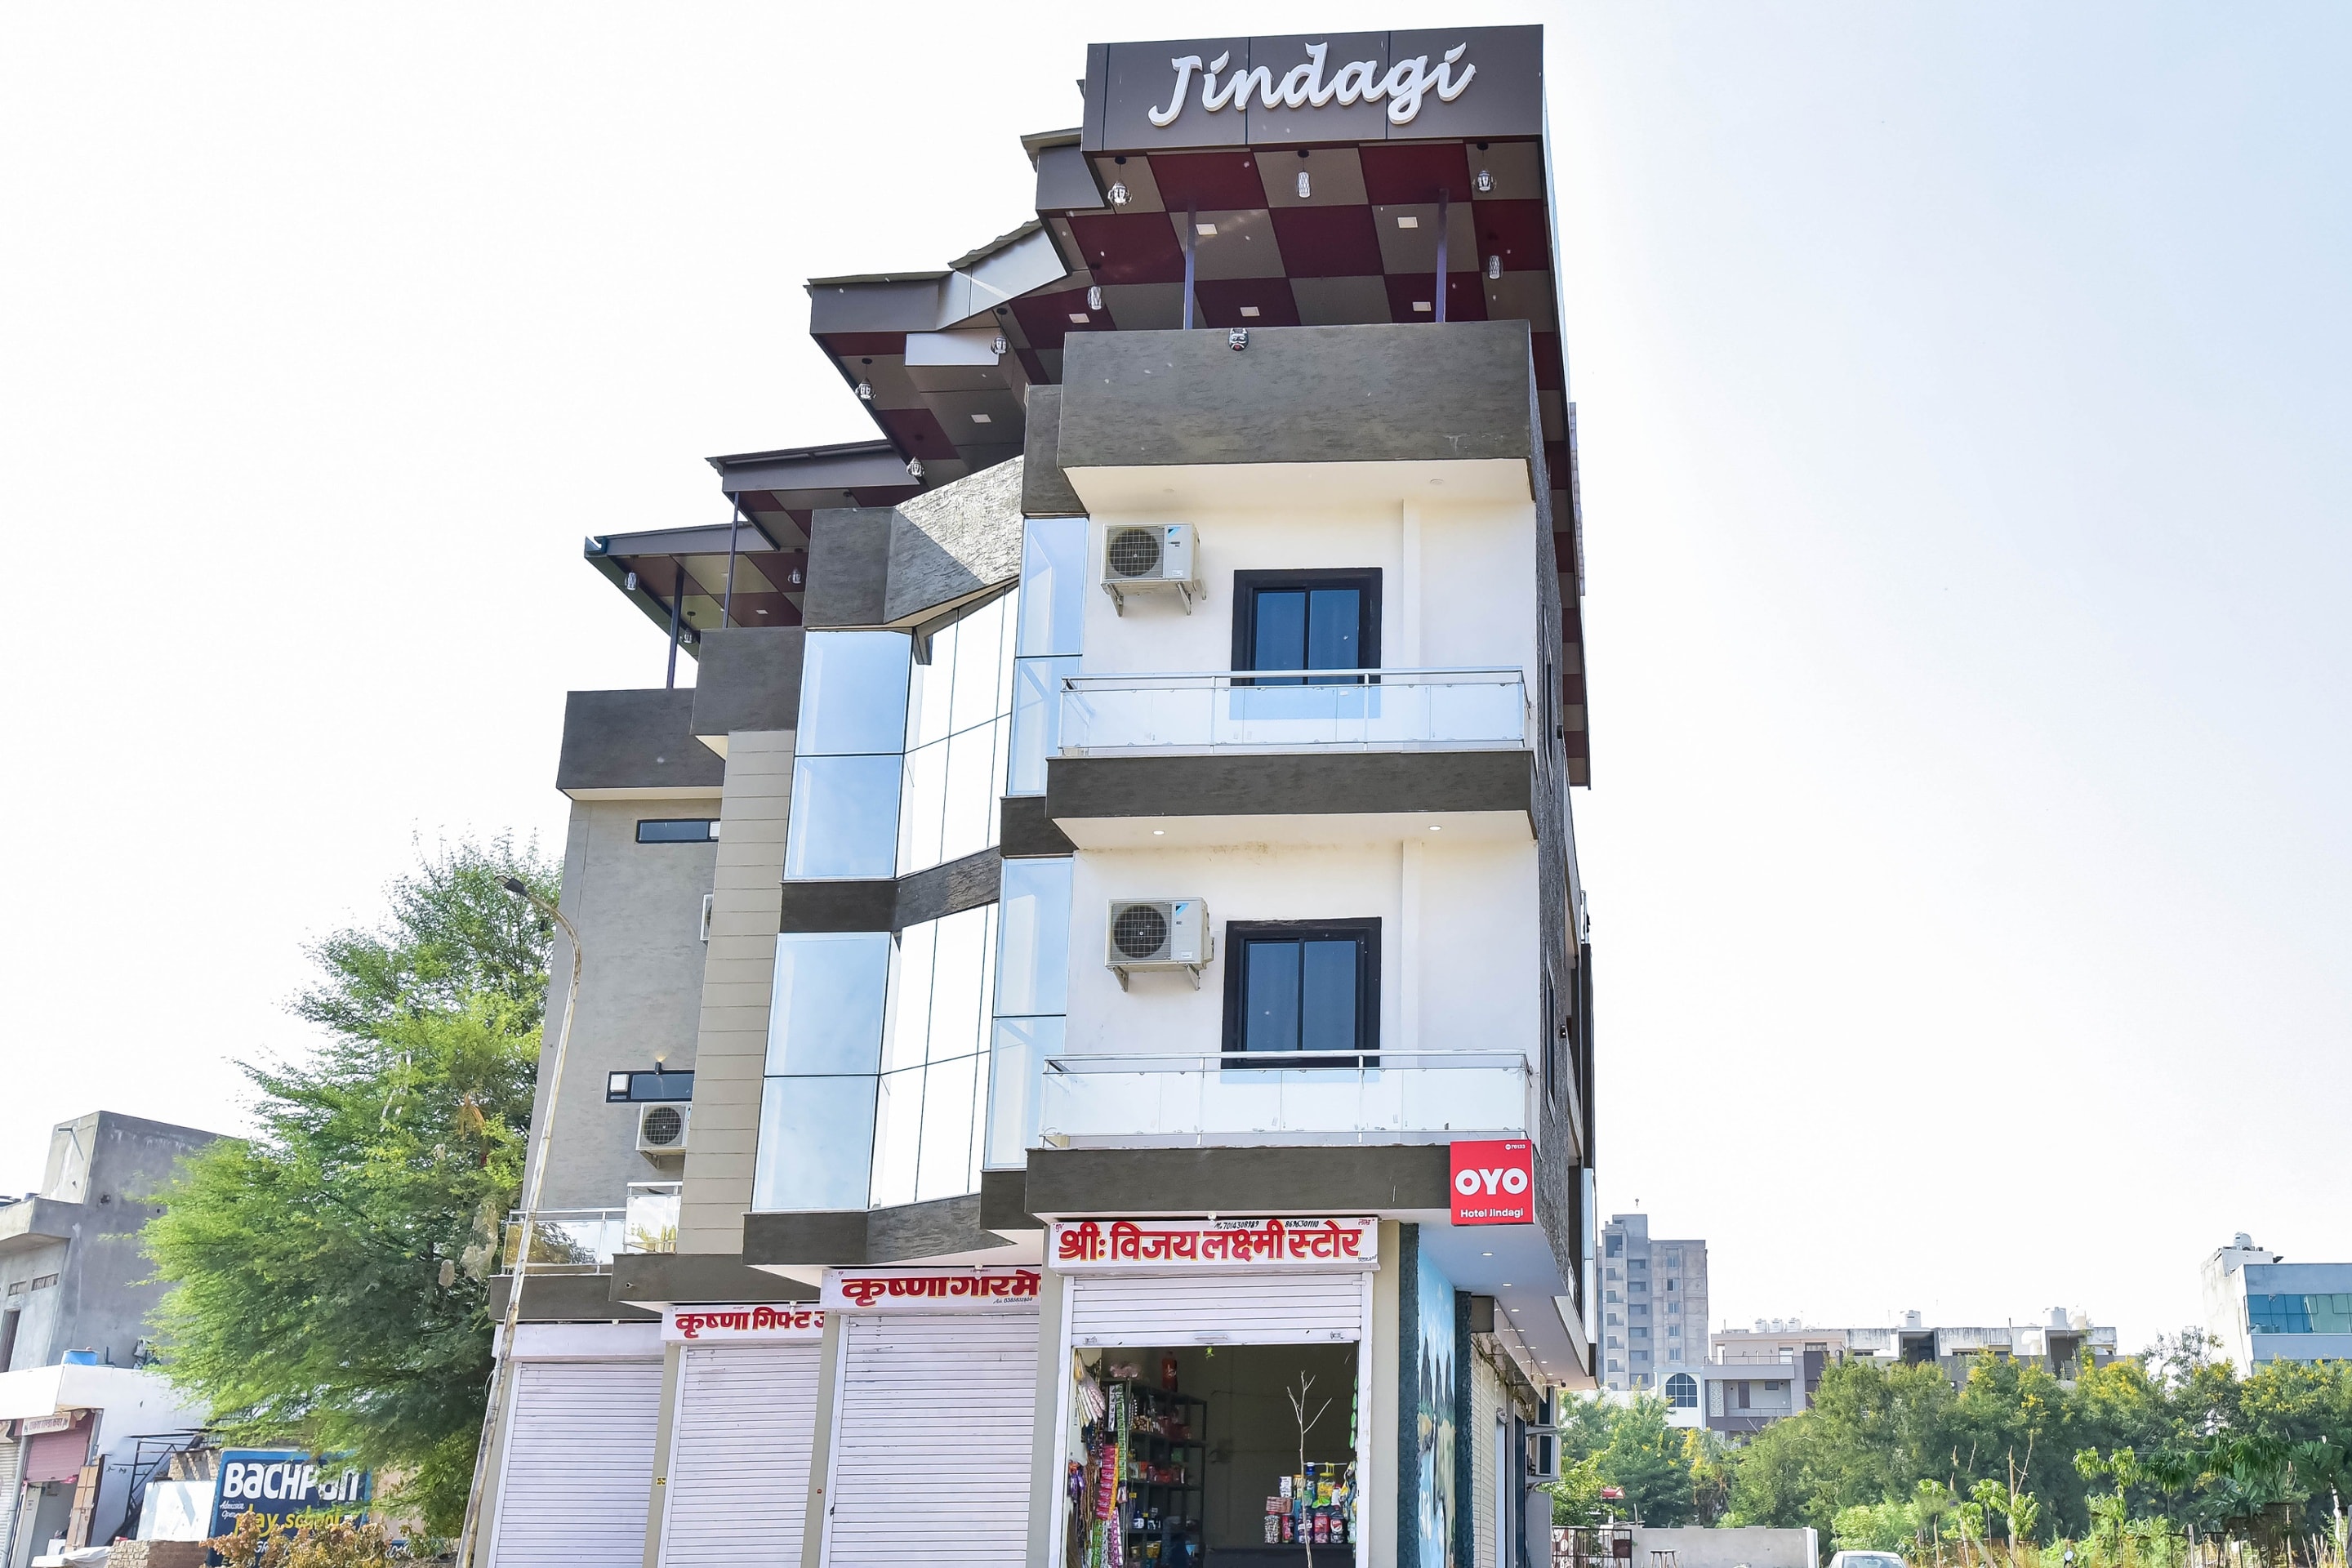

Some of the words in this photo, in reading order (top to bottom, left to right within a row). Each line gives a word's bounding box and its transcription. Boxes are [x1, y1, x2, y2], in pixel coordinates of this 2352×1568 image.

[1147, 42, 1477, 126] Jindagi
[1454, 1167, 1528, 1196] OYO
[1460, 1209, 1487, 1218] Hotel
[1490, 1208, 1524, 1218] Jindagi
[1289, 1220, 1362, 1258] स्टोर
[841, 1277, 950, 1307] कृष्णा
[951, 1268, 1042, 1297] गारमे
[675, 1312, 751, 1339] कृष्णा
[752, 1306, 812, 1330] गिफ्ट
[285, 1504, 341, 1530] schol
